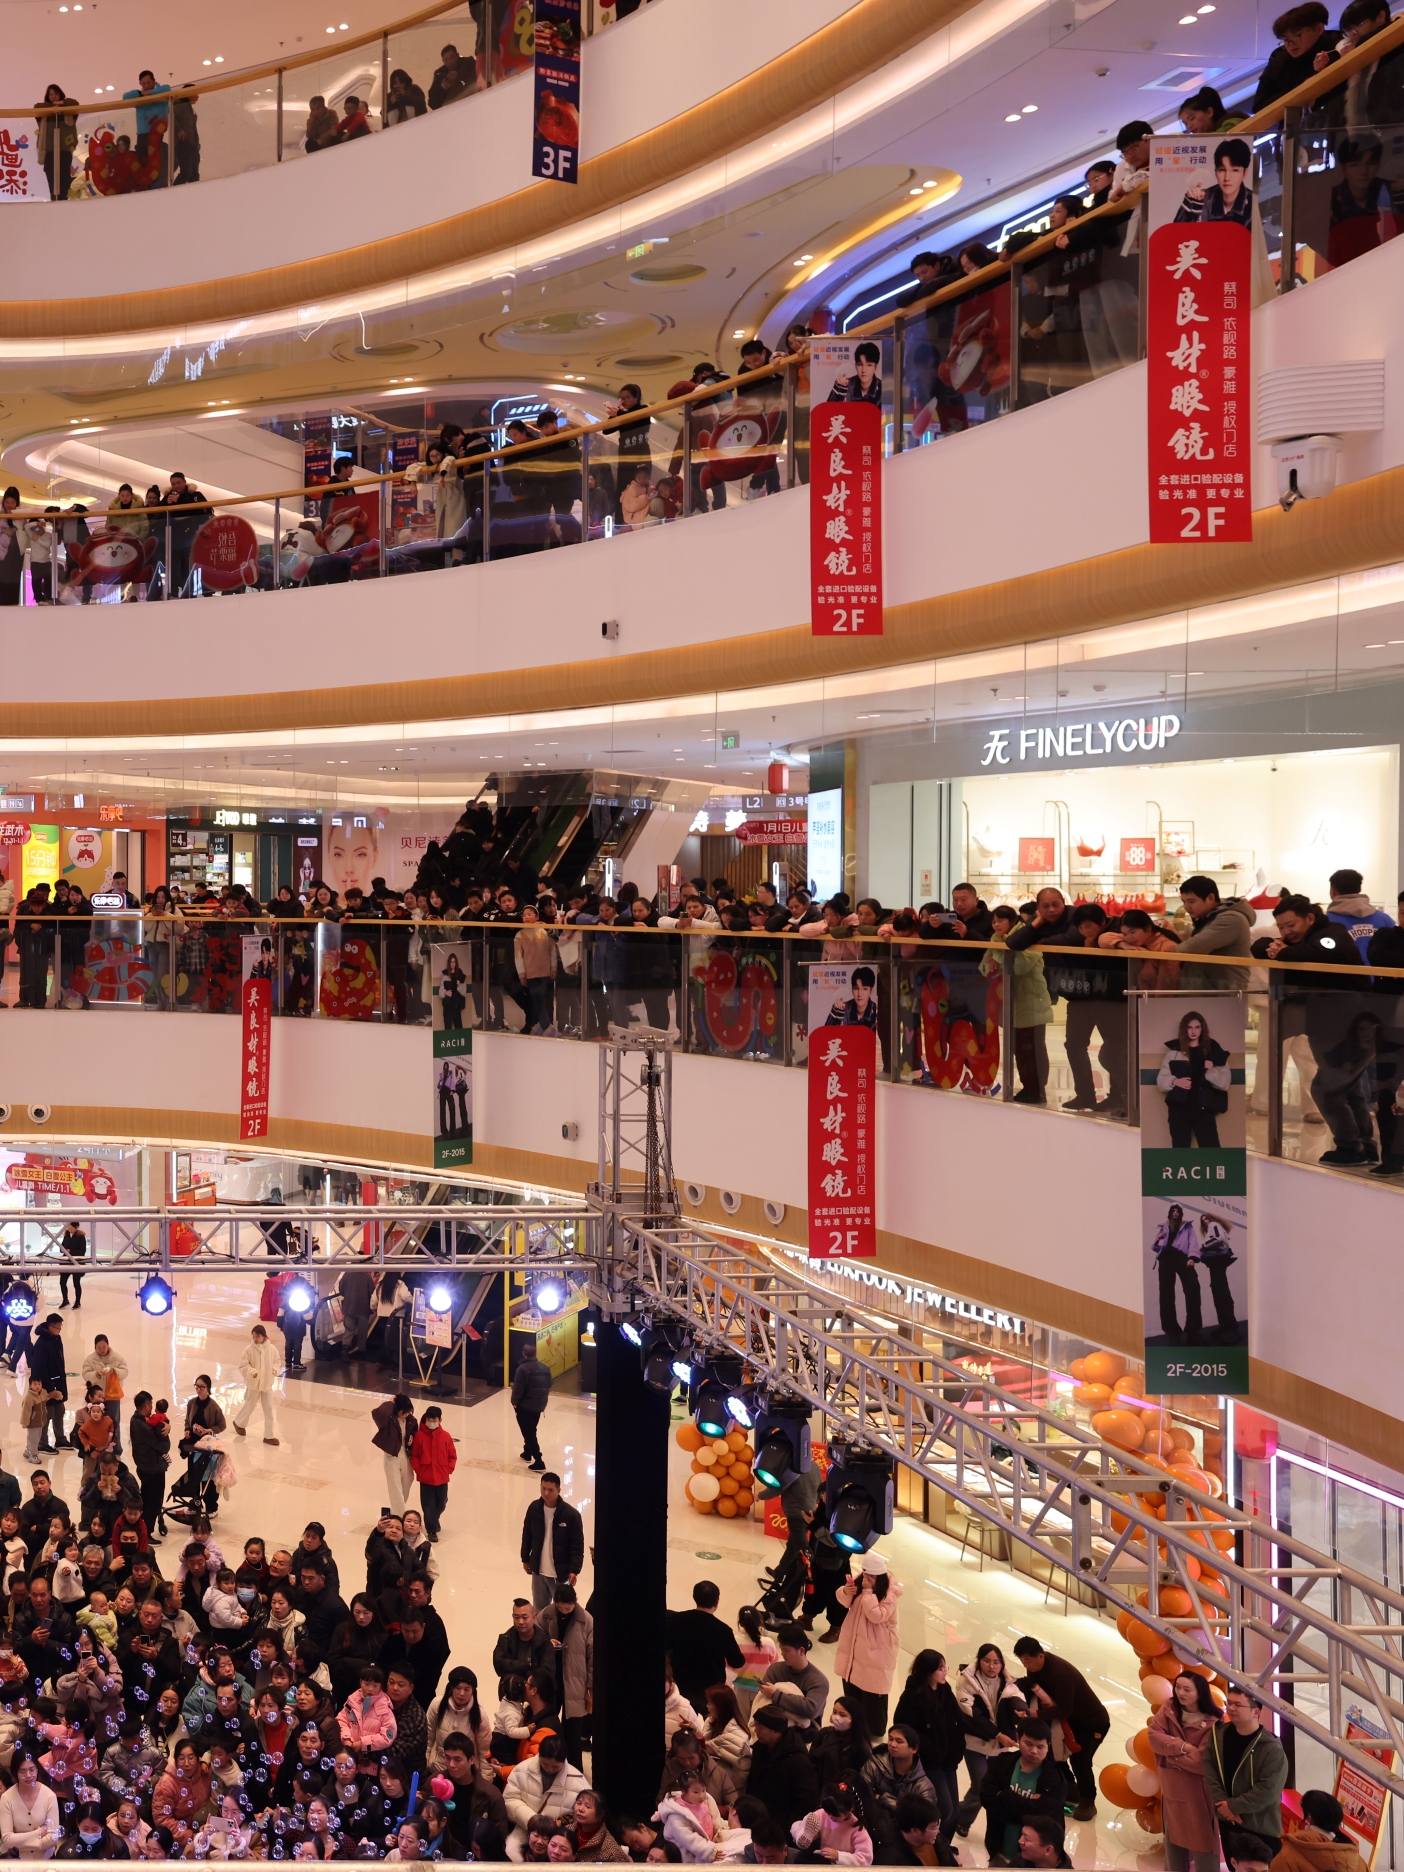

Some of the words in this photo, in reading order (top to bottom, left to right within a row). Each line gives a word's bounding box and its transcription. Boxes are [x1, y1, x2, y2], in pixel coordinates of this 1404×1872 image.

[541, 146, 572, 178] 3F
[1223, 282, 1236, 309] 蔡司
[1223, 317, 1236, 359] 依视路
[1166, 240, 1214, 460] 吴良材眼镜
[1223, 367, 1236, 394] 豪雅
[1223, 401, 1236, 457] 授权门店
[862, 446, 872, 466] 蔡司
[862, 471, 872, 502] 依视路
[1158, 473, 1244, 485] 全套进口验配设备
[822, 415, 856, 575] 吴良材眼镜
[1158, 489, 1197, 499] 验光准
[1206, 488, 1244, 498] 更专业
[862, 507, 872, 527] 豪雅
[1180, 507, 1226, 538] 2F
[862, 532, 872, 574] 授权门店
[818, 584, 877, 593] 全套进口验配设备
[818, 596, 845, 604] 验光准
[850, 596, 877, 604] 更专业
[832, 608, 865, 632] 2F
[1020, 714, 1180, 760] FINELYCUP
[746, 798, 760, 808] L2
[401, 836, 448, 849] 贝尼诗
[1130, 847, 1145, 865] 88
[246, 987, 260, 1097] 吴良材眼镜
[857, 1068, 866, 1088] 蔡司
[820, 1038, 851, 1197] 吴良材眼镜
[857, 1093, 866, 1123] 依视路
[248, 1119, 261, 1136] 2F
[857, 1128, 866, 1149] 豪雅
[442, 1148, 465, 1158] 2F-2015
[13, 1168, 42, 1179] 冰雪女王
[46, 1171, 73, 1182] 白雪公主
[857, 1154, 866, 1195] 授权门店
[1163, 1166, 1210, 1179] RACI
[38, 1181, 70, 1193] TIME/1.1
[815, 1206, 871, 1215] 全套进口验配设备
[815, 1217, 841, 1226] 验光准
[846, 1217, 871, 1226] 更专业
[828, 1230, 859, 1254] 2F
[1166, 1363, 1227, 1377] 2F-2015
